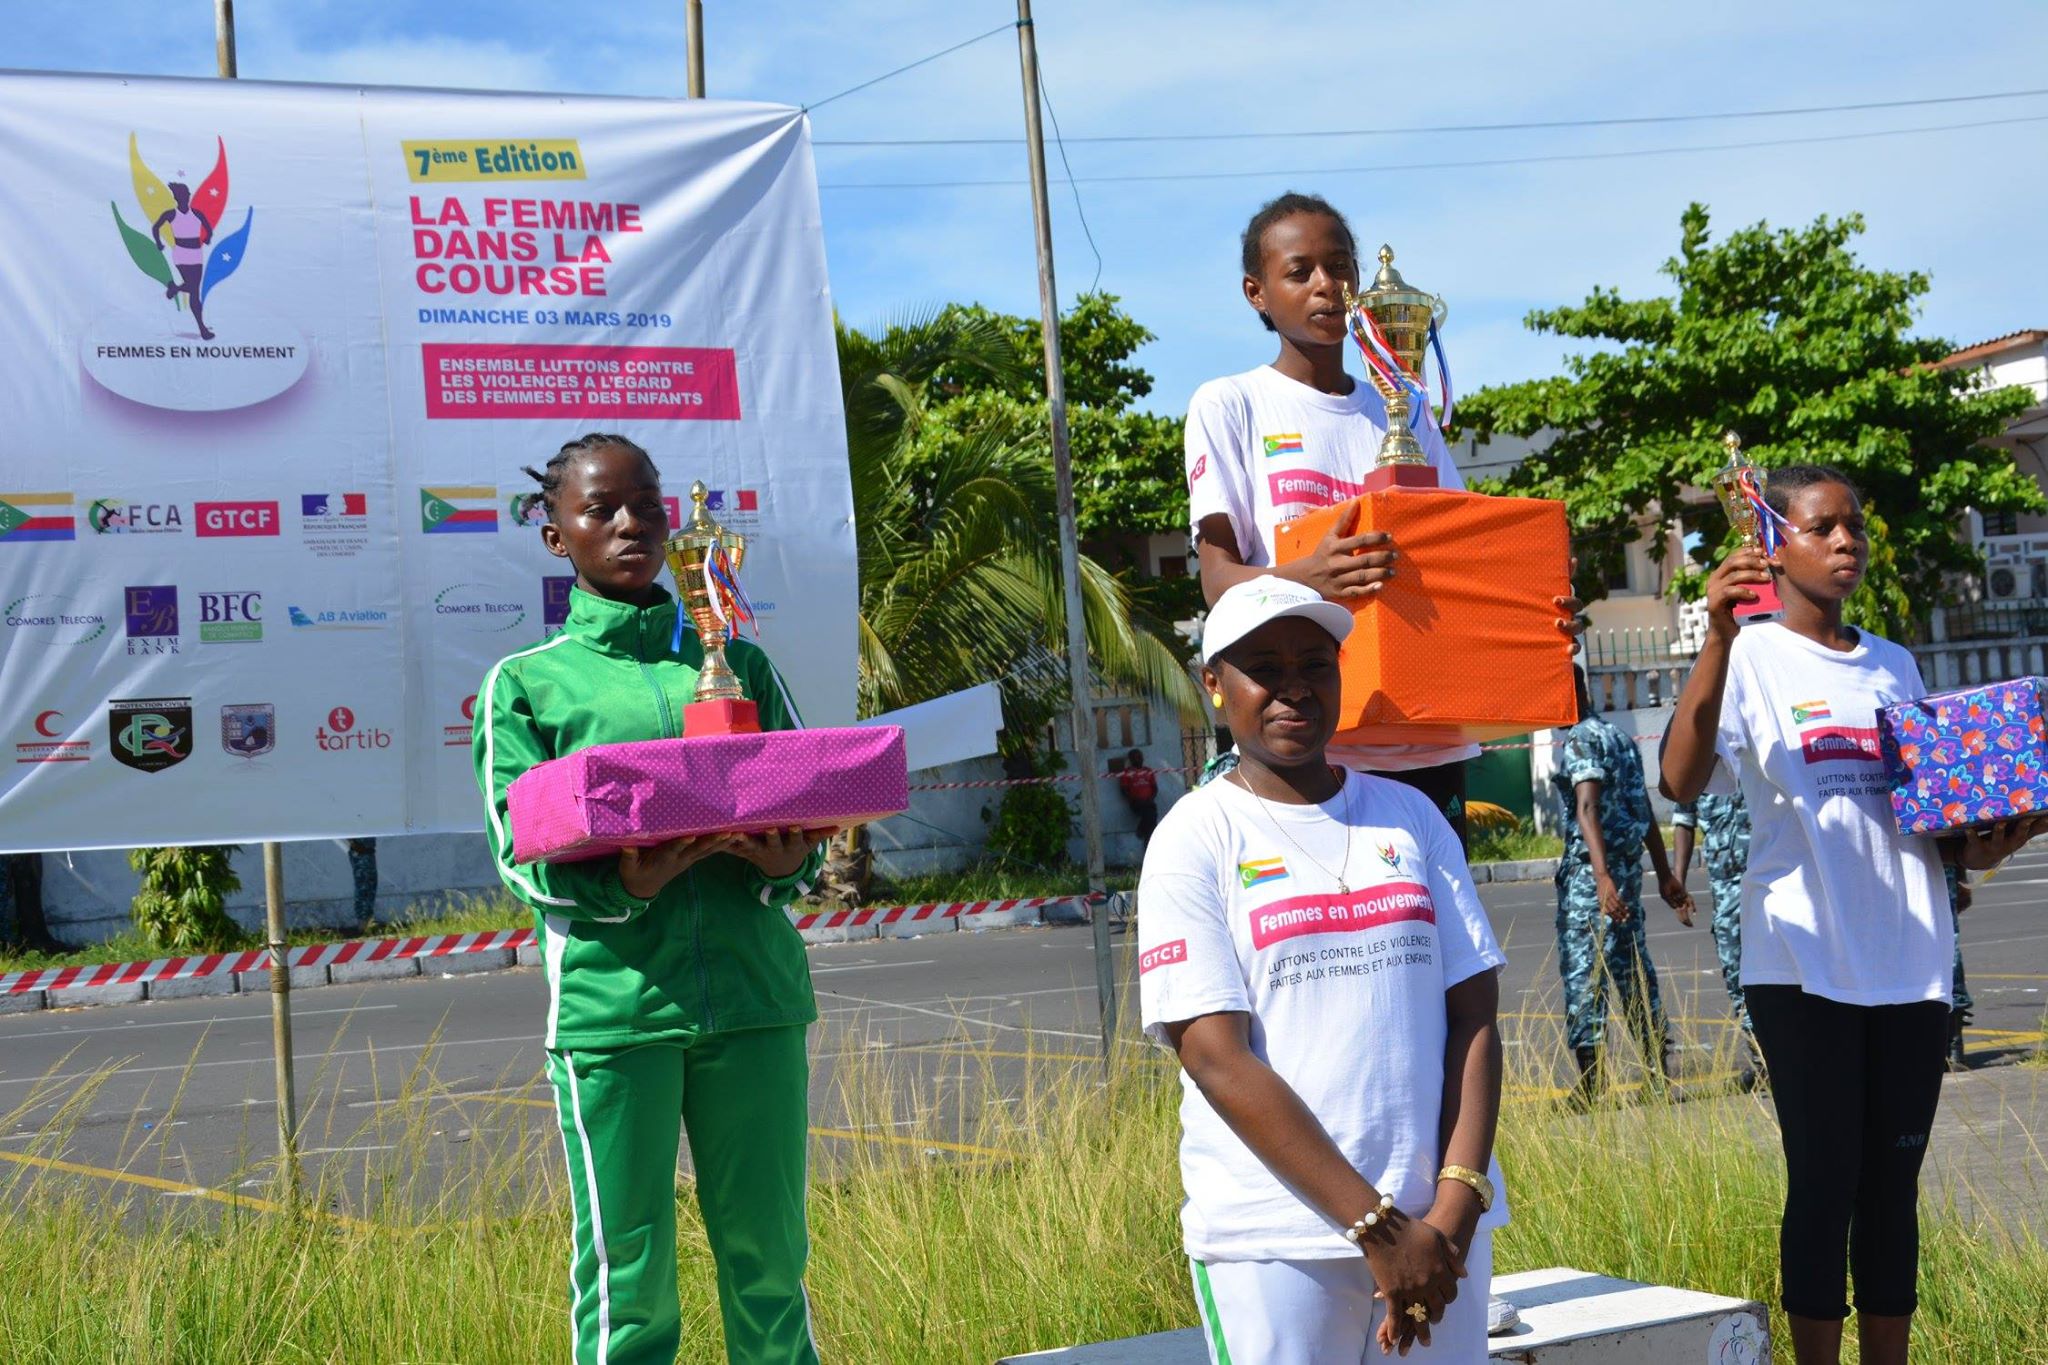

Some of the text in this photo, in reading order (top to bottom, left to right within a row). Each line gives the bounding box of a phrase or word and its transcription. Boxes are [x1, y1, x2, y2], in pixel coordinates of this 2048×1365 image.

[414, 144, 577, 176] 7ème Edition
[410, 196, 643, 232] LA FEMME
[413, 229, 612, 263] DANS LA
[416, 263, 607, 296] COURSE
[419, 308, 671, 328] DIMANCHE 03 MARS 2019
[97, 346, 296, 359] FEMMES EN MOUVEMENT
[439, 359, 694, 374] ENSEMBLE LUTTONS CONTRE
[441, 374, 672, 389] LES VIOLENCES A L'EGARD
[442, 390, 703, 405] DES FEMMES ET DES ENFANTS
[1278, 478, 1329, 498] Femmes
[129, 505, 182, 526] FCA
[206, 509, 271, 529] GTCF
[199, 593, 262, 622] BFC
[317, 611, 387, 622] AB Aviation
[436, 603, 524, 614] COMORES TELECOM
[6, 615, 104, 626] COMORES TELECOM
[128, 638, 178, 647] EXIM
[128, 646, 179, 655] BANK
[316, 727, 390, 751] tartib
[1809, 736, 1875, 752] Femmes en
[1817, 773, 1856, 785] LUTTONS
[1819, 787, 1846, 799] FAITES
[1848, 787, 1863, 796] AUX
[1260, 893, 1433, 934] Femmes en mouvement
[1143, 945, 1181, 968] GTCF
[1268, 936, 1431, 975] LUTTONS CONTRE LES VIOLENCES
[1270, 953, 1432, 991] FAITES AUX FEMMES ET AUX ENFANTS
